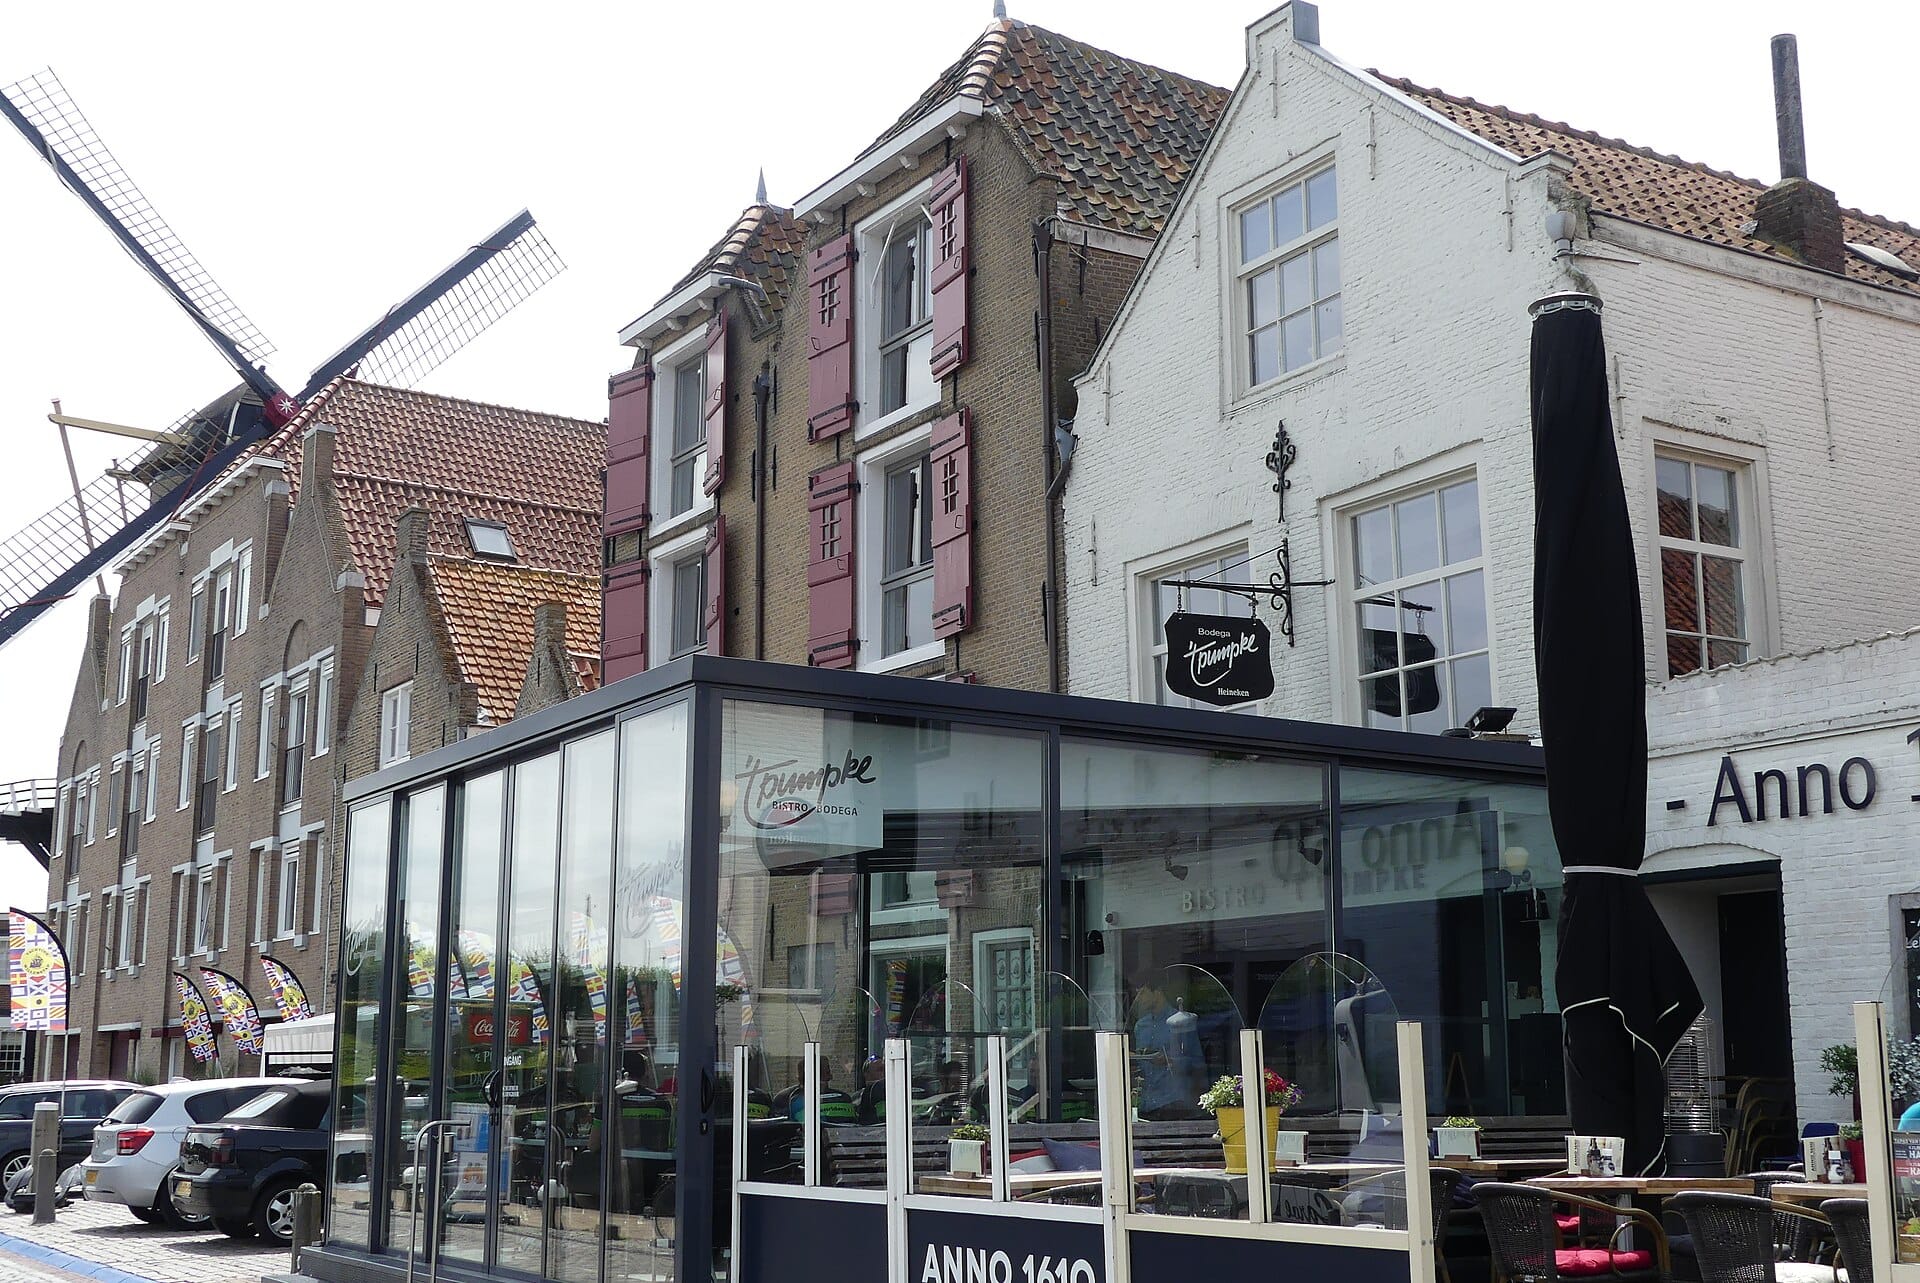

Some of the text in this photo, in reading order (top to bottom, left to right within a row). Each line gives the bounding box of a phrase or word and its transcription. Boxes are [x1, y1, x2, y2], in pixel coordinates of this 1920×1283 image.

[1197, 627, 1231, 639] Bodega
[1217, 687, 1250, 698] Heineken
[1707, 756, 1876, 827] Anno
[772, 800, 858, 817] BISTRO BODEGA
[921, 1243, 1096, 1283] ANNO 1610
